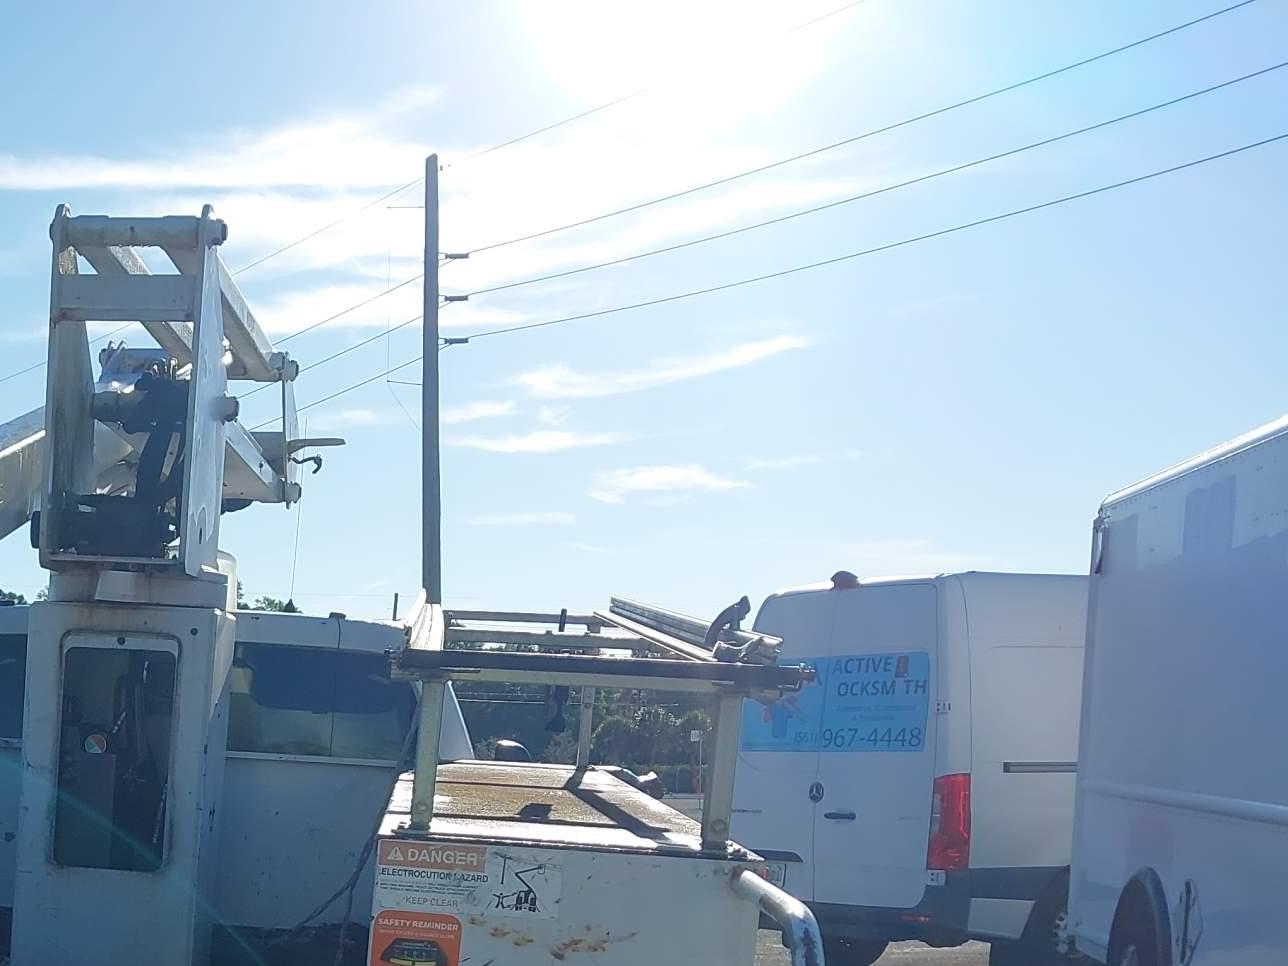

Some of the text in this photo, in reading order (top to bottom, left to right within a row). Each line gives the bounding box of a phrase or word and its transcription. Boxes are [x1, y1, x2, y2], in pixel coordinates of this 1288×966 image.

[832, 656, 893, 674] ACTIVE
[823, 727, 921, 748] 967-4448
[407, 848, 478, 866] DANGER
[381, 867, 451, 880] ELECTROCUTION
[406, 895, 458, 908] KEEP CLEAR
[378, 918, 458, 932] SAFETY REMINDER
